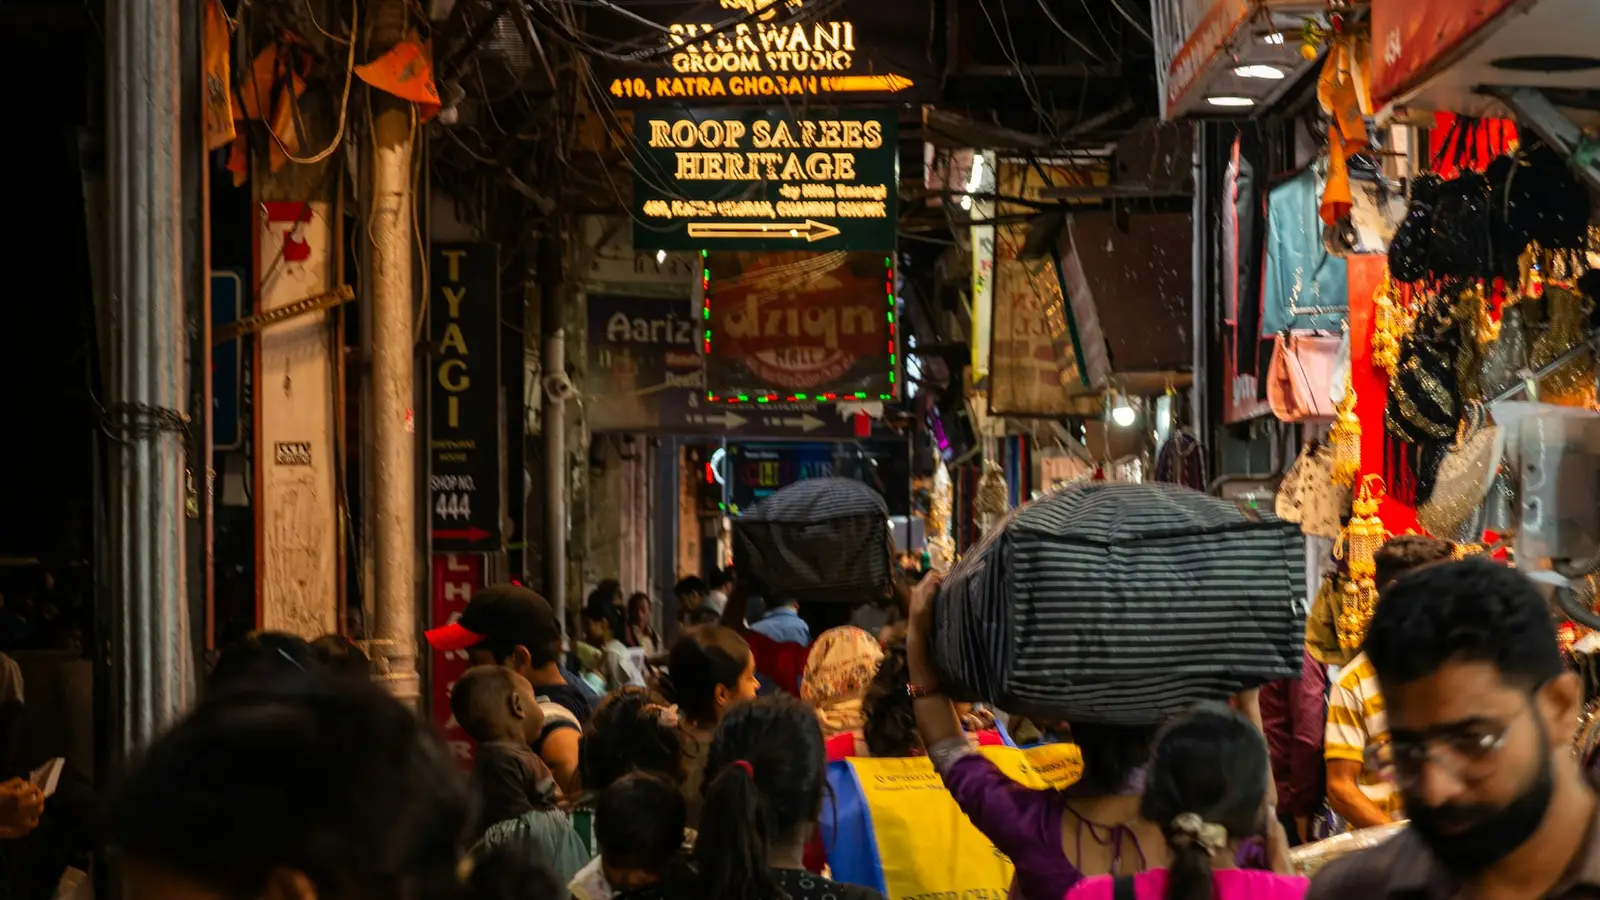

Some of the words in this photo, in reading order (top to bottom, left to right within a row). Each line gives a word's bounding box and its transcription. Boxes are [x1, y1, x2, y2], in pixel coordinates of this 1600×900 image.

[671, 52, 762, 73] GROOM
[766, 51, 852, 71] STUDIO
[609, 78, 652, 99] 410,
[656, 77, 727, 97] KATRA
[648, 120, 746, 148] ROOP
[752, 120, 883, 148] SAREES
[674, 152, 857, 181] HERITAGE
[438, 250, 471, 428] TYAGI
[431, 474, 457, 491] SHOP
[435, 492, 471, 520] 444
